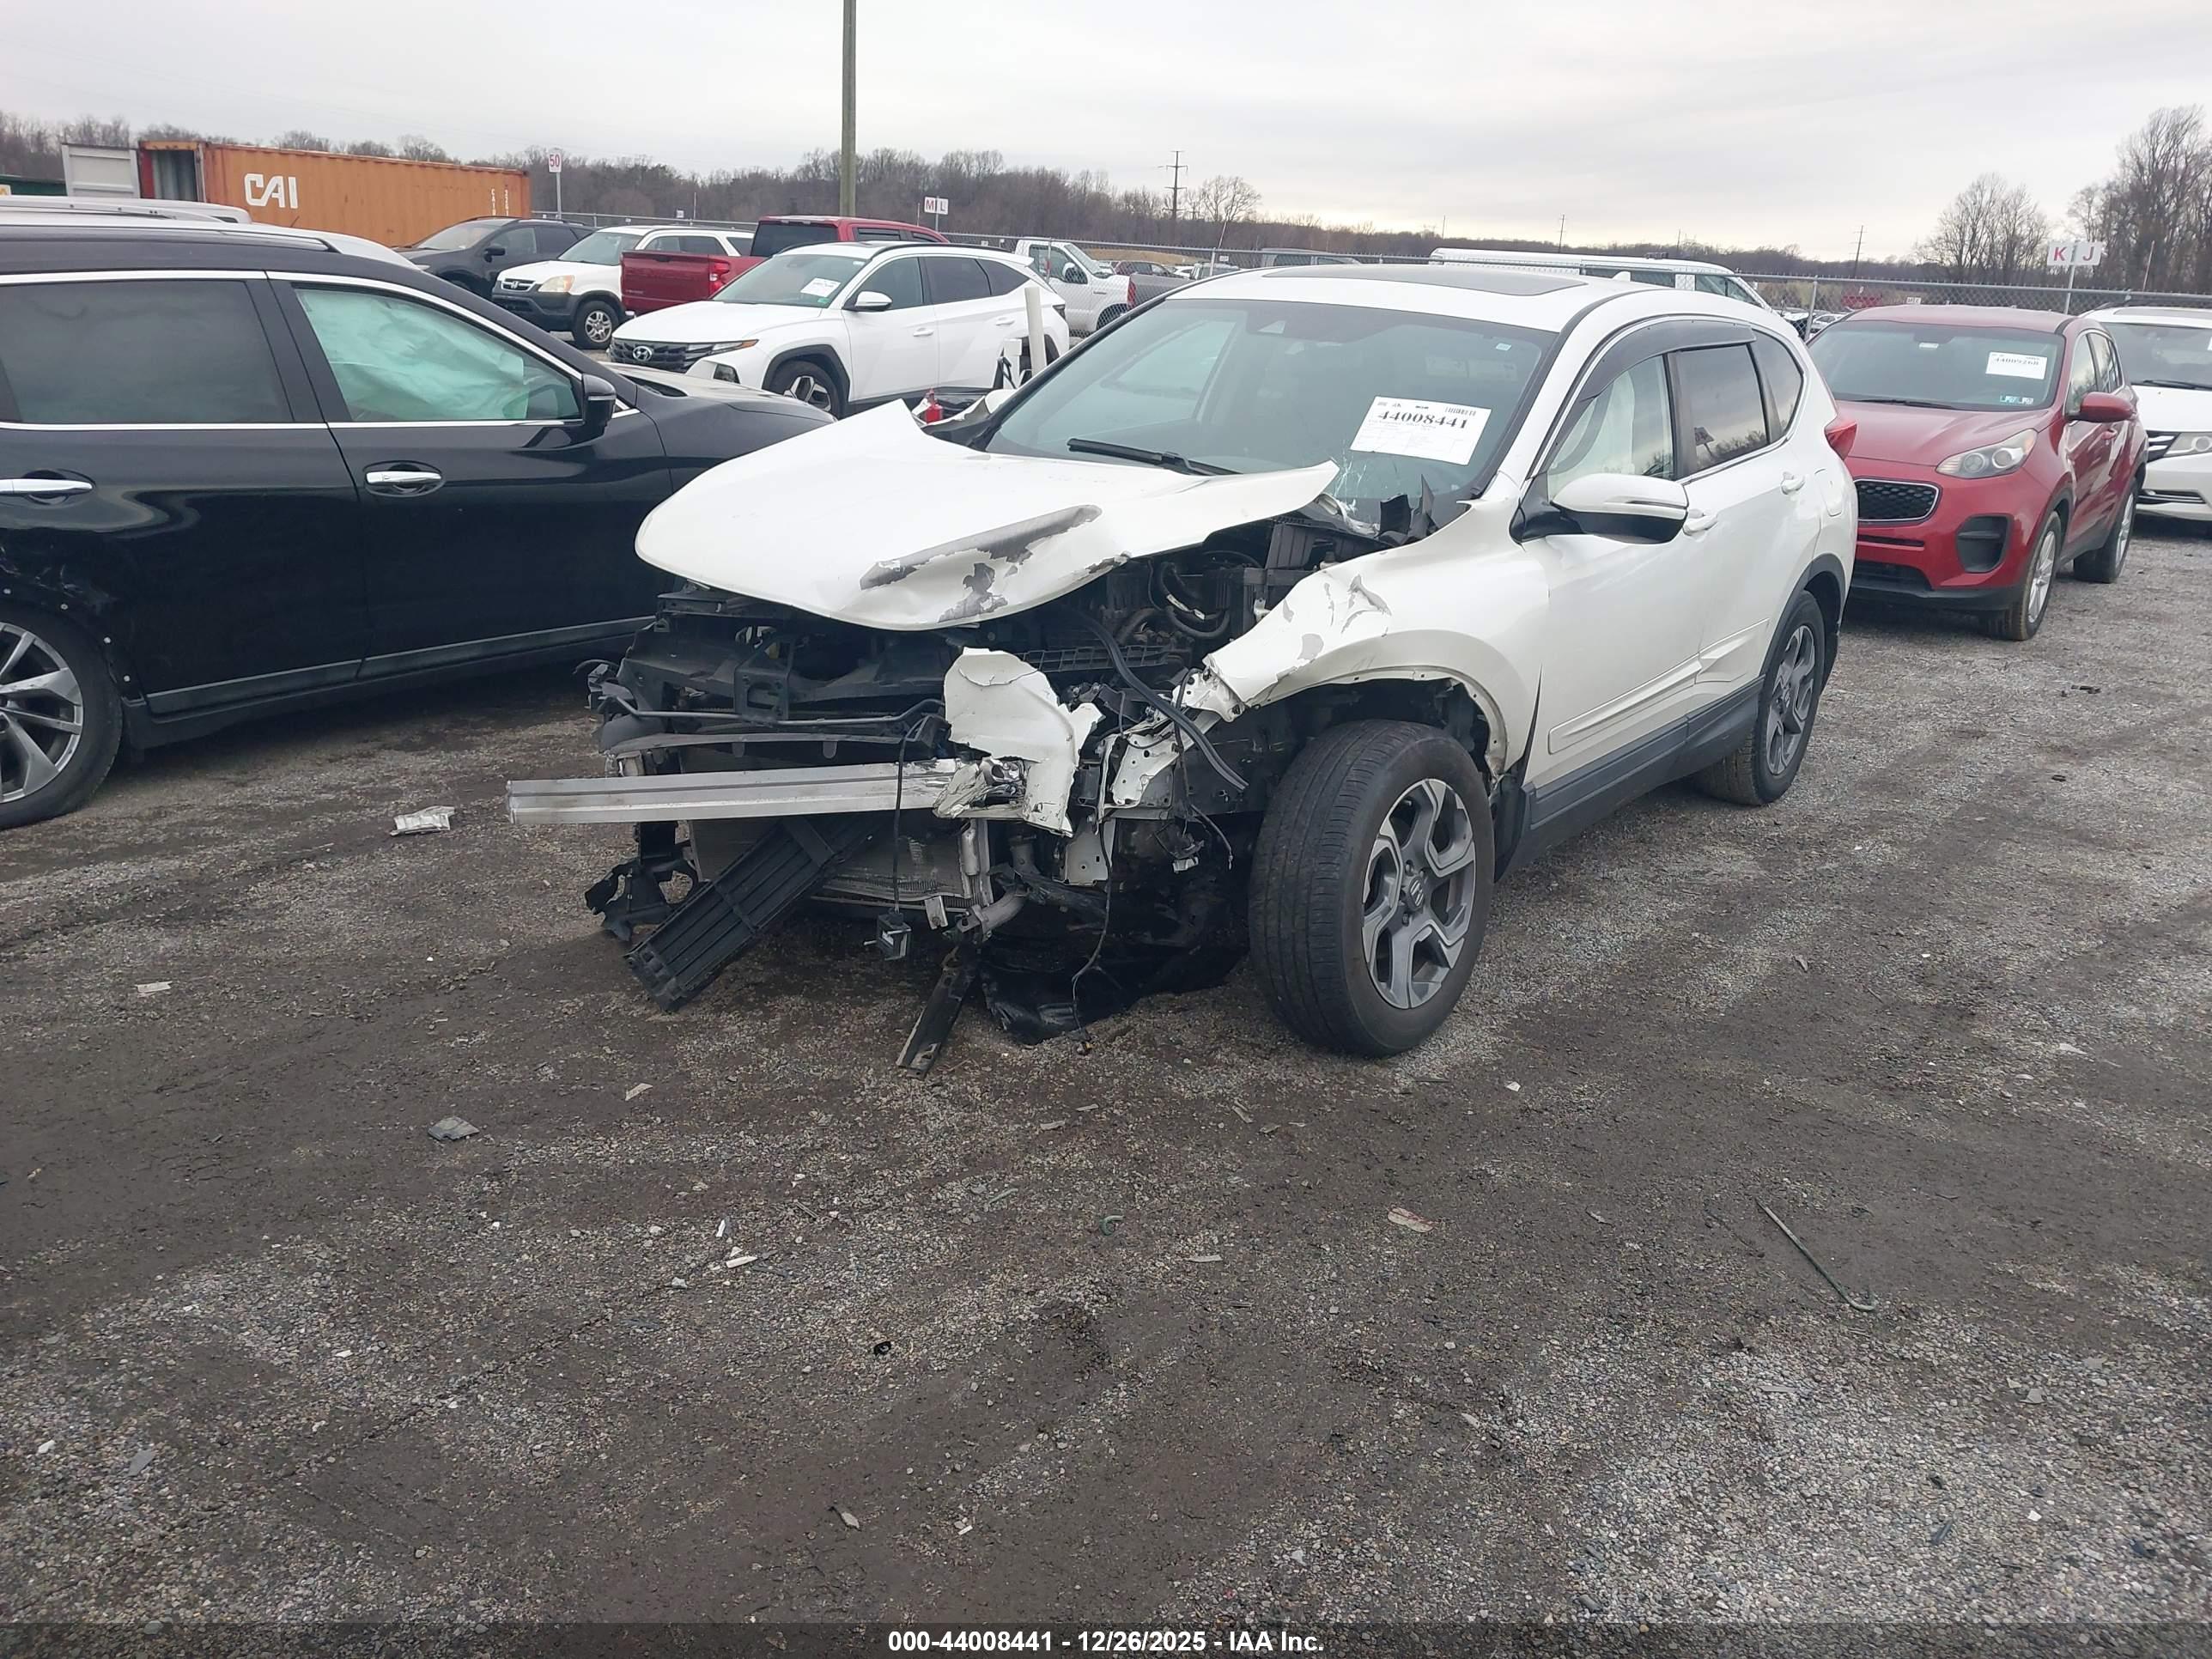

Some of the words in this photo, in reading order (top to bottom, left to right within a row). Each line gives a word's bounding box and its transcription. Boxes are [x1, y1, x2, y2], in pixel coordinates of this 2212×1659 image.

[550, 154, 561, 167] 50
[244, 173, 299, 209] CAI
[926, 199, 934, 211] M
[940, 200, 946, 212] L
[2053, 246, 2067, 262] K
[2082, 246, 2095, 262] J
[1377, 410, 1468, 429] 44008441
